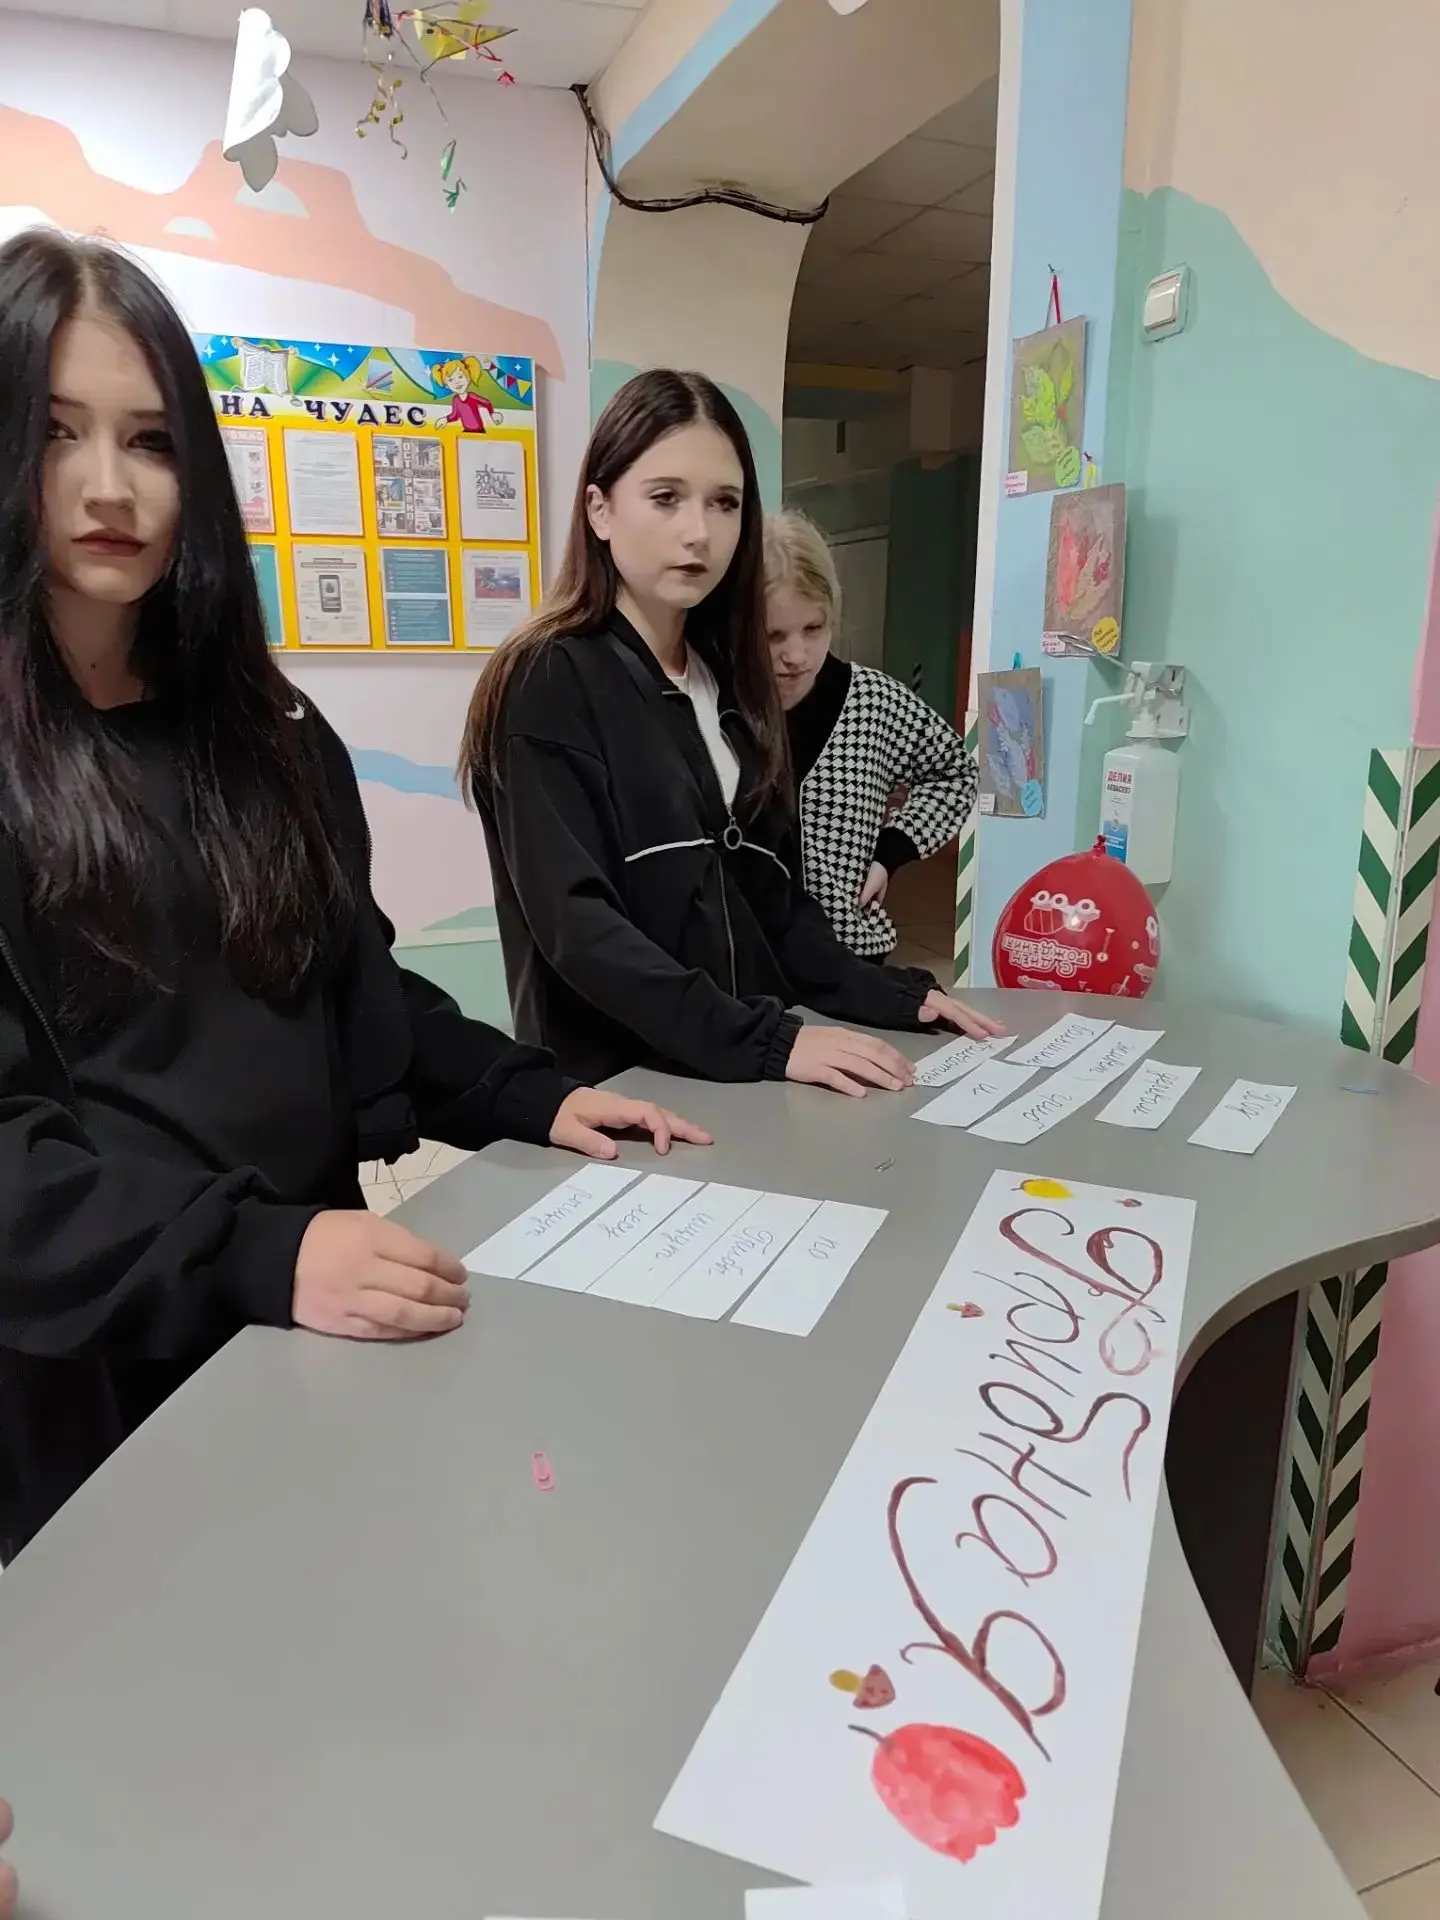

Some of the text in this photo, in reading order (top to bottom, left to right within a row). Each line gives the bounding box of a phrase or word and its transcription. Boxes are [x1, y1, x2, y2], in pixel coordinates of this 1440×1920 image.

[303, 399, 427, 426] ЧУДЕС
[1003, 936, 1088, 966] РОЖДЕНИЯ
[1010, 948, 1055, 971] ДНЕМ
[807, 1237, 840, 1260] по
[888, 1206, 1166, 1764] Грибная
